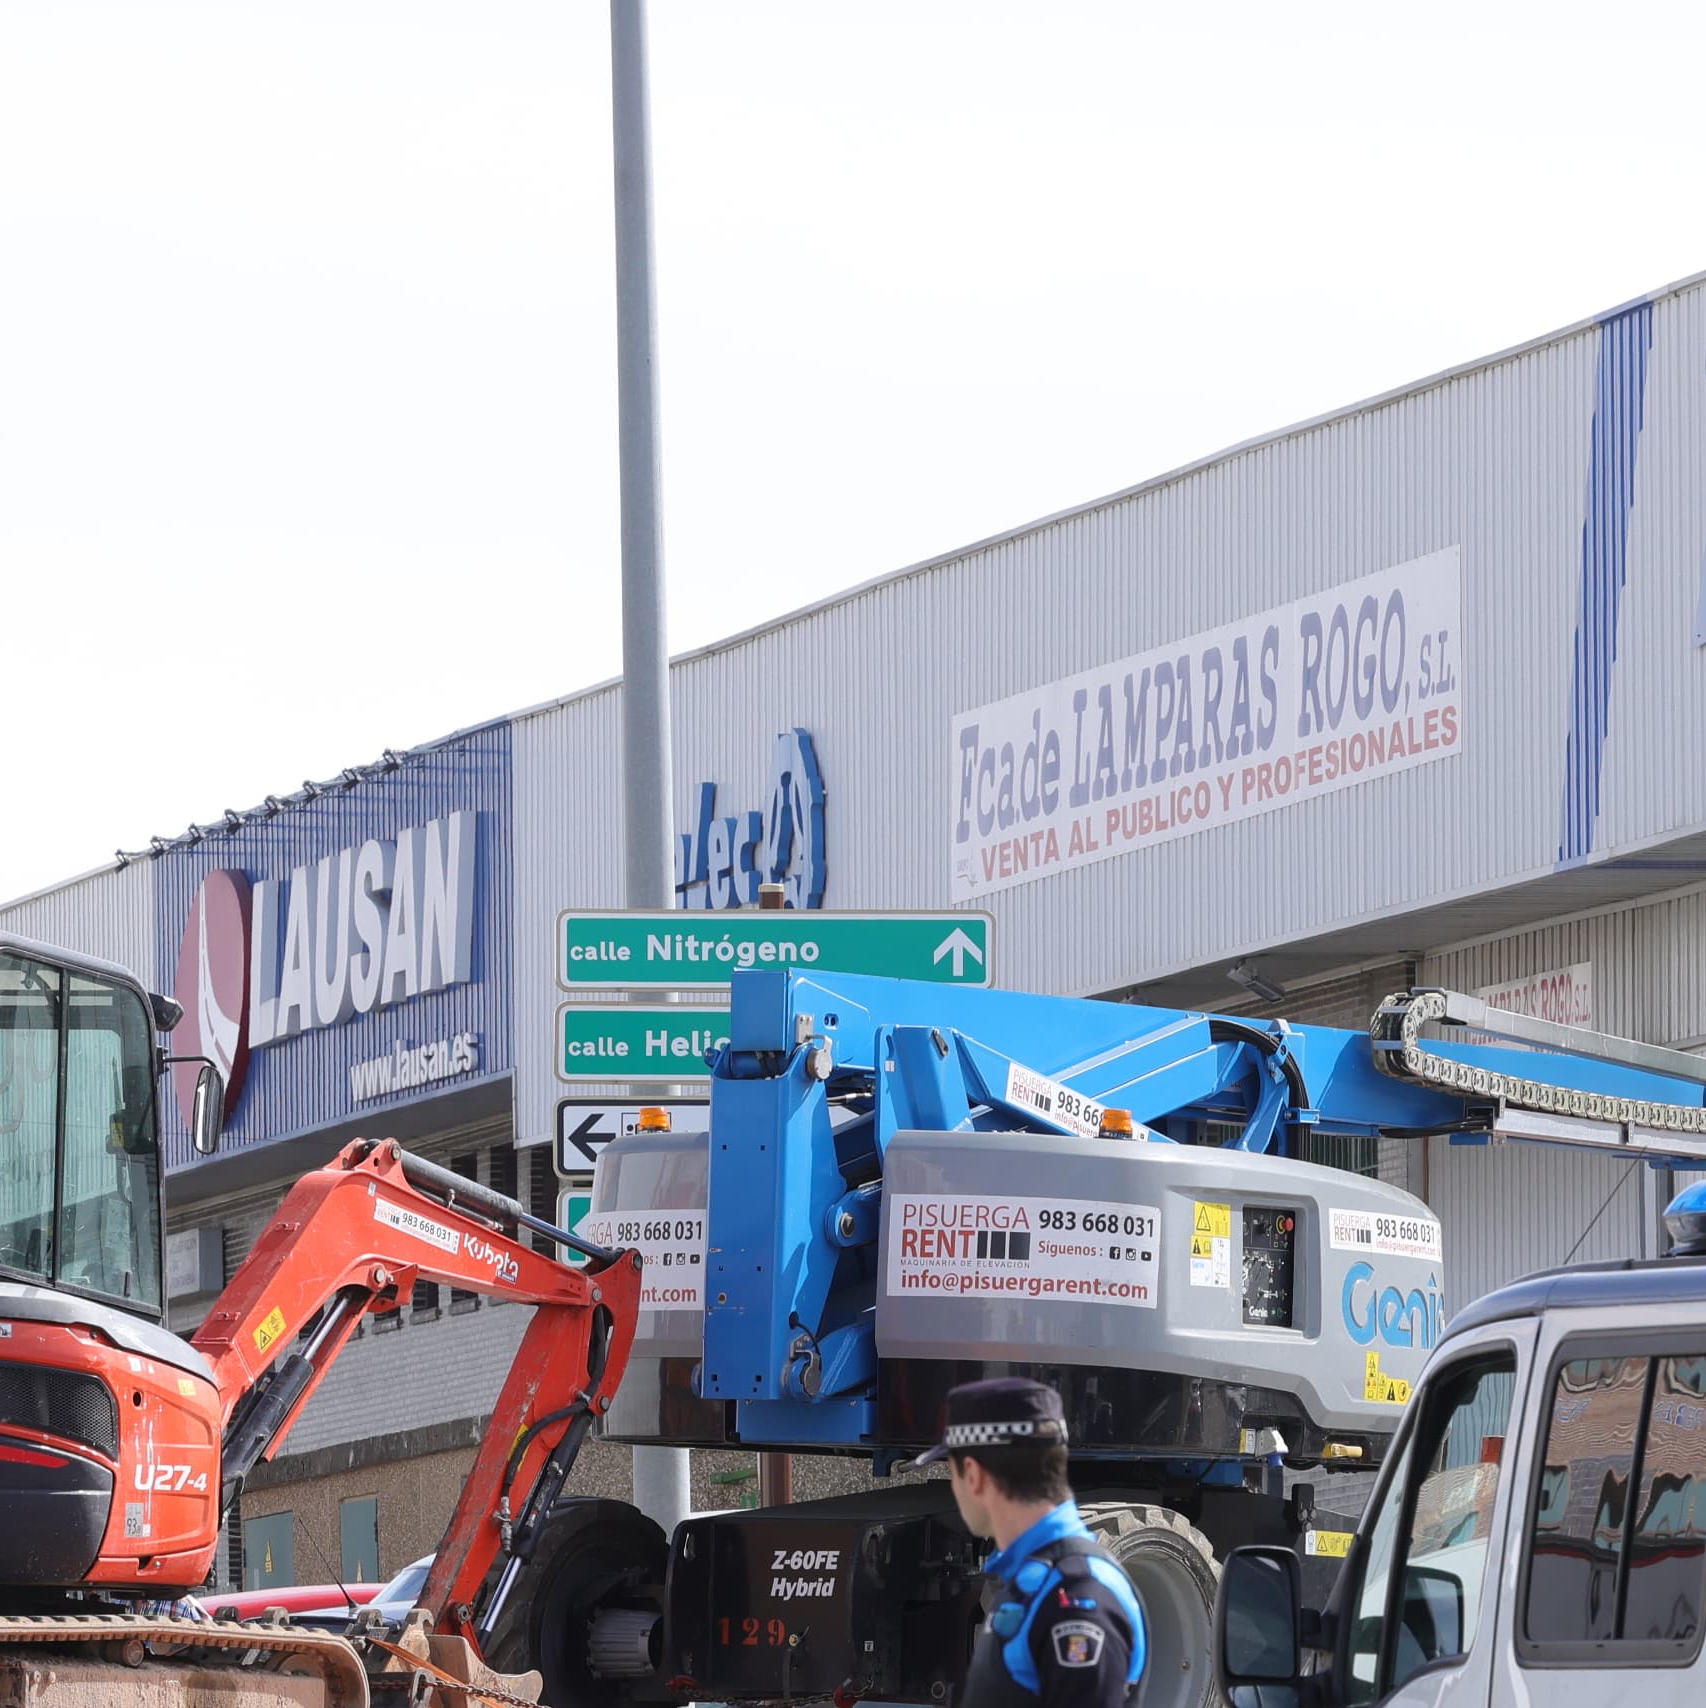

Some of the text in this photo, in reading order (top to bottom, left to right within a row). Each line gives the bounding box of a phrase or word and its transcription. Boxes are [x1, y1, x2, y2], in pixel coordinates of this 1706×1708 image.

[1068, 625, 1280, 808] LAMPARAS
[1418, 629, 1456, 700] S.L.
[980, 705, 1459, 883] VENTA AL PUBLICO Y PROFESIONALES
[248, 809, 477, 1050] LAUSAN
[570, 933, 820, 967] calle Nitrógeno
[568, 1036, 629, 1056] calle
[349, 1032, 478, 1103] www.lausan.es
[1013, 1069, 1052, 1096] PISUERGA
[1011, 1082, 1035, 1103] RENT
[1057, 1091, 1081, 1117] 983
[402, 1213, 418, 1228] 983
[419, 1220, 435, 1236] 668
[436, 1229, 451, 1243] 031
[617, 1222, 641, 1242] 983
[643, 1221, 671, 1241] 668
[674, 1220, 702, 1241] 031
[902, 1203, 1155, 1238] PISUERGA 983 668 031
[1333, 1213, 1436, 1244] PISUERGA 983 668 031
[1334, 1226, 1356, 1242] RENT
[463, 1232, 519, 1278] Kubota
[901, 1228, 976, 1259] RENT
[900, 1259, 1031, 1269] MAQUINARIA DE ELEVACIÓN
[901, 1270, 1148, 1300] info@pisuergarent.com
[134, 1464, 207, 1492] U27-4
[771, 1551, 840, 1570] Z-60FE
[770, 1577, 835, 1600] Hybrid
